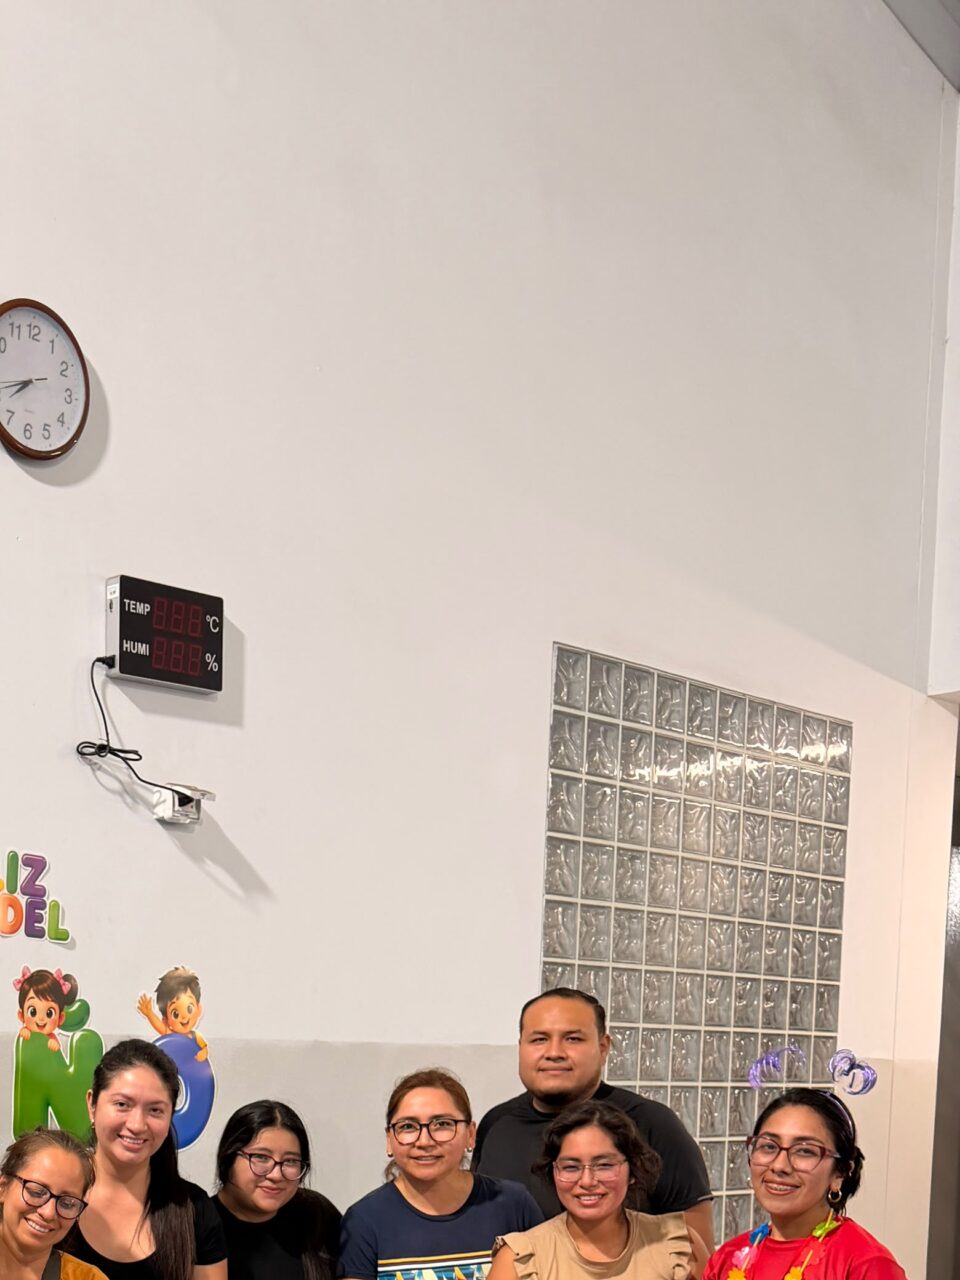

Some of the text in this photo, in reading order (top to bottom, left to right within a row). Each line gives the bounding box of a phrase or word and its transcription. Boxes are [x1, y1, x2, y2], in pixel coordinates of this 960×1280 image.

[8, 321, 21, 340] 11
[26, 322, 41, 342] 12
[49, 338, 56, 354] 1
[59, 361, 69, 377] 2
[64, 388, 73, 404] 3
[6, 409, 15, 426] 7
[57, 412, 65, 427] 4
[23, 423, 33, 440] 6
[42, 424, 51, 440] 5
[123, 598, 151, 616] TEMP
[123, 639, 150, 656] HUMI
[205, 653, 219, 672] %
